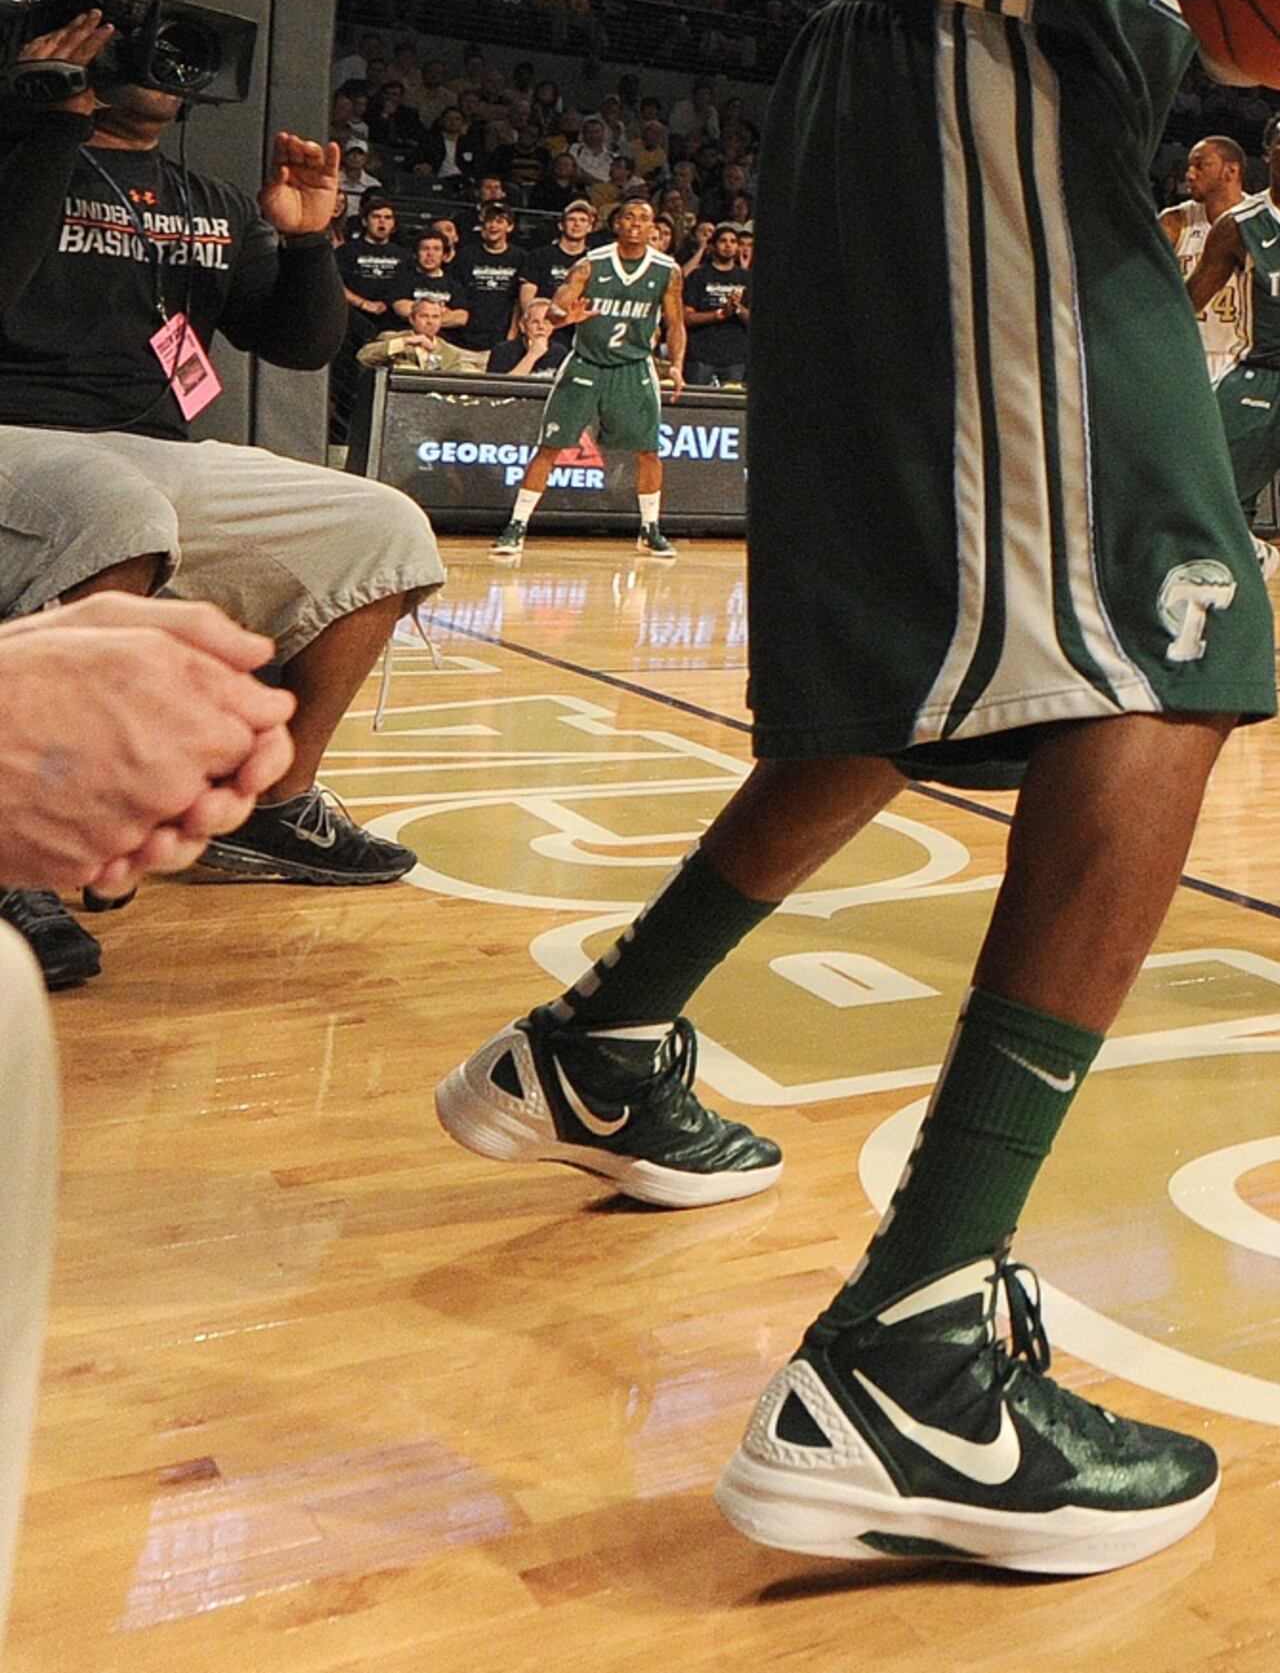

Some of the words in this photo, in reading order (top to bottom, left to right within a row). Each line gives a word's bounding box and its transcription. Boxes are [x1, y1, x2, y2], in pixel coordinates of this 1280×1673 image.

[58, 225, 230, 270] BASKTBALL
[592, 297, 652, 318] TULANE
[610, 323, 627, 347] 2
[657, 424, 740, 460] SAVE
[505, 467, 604, 488] PWER
